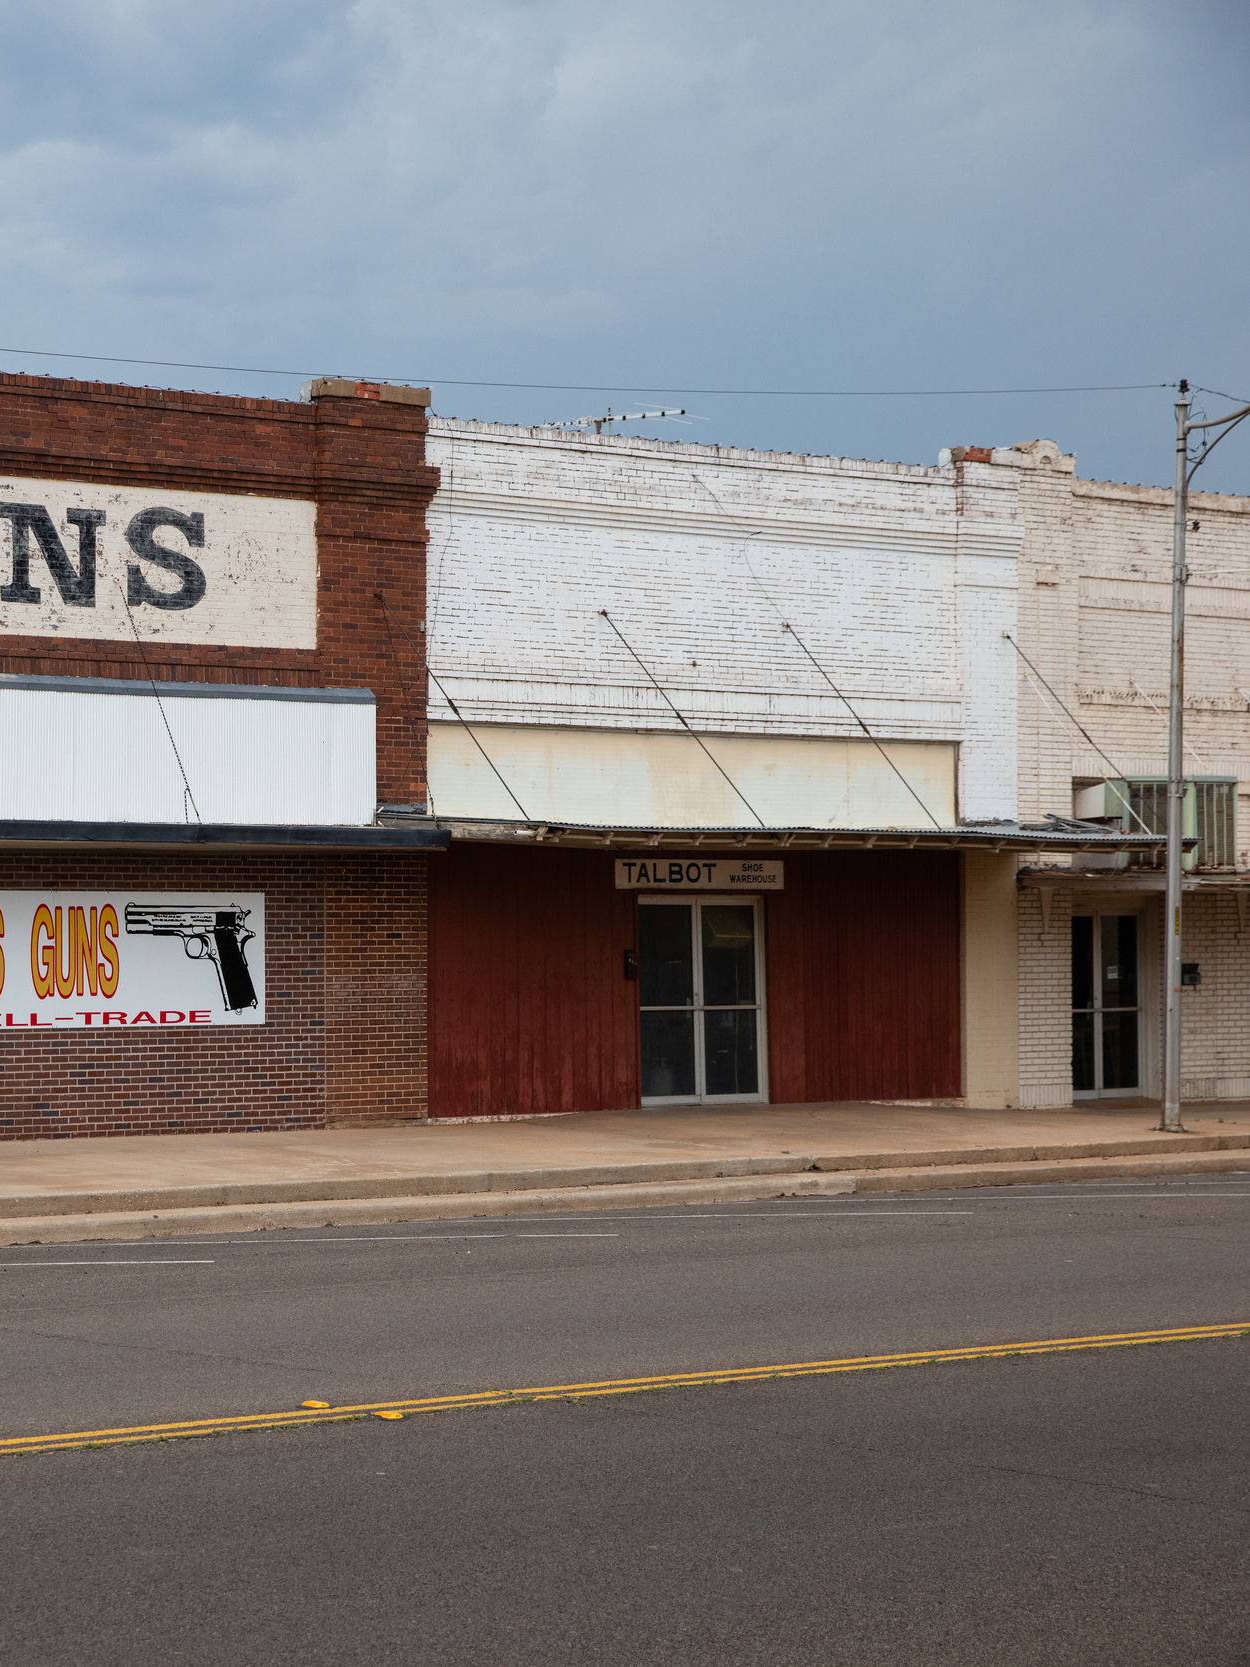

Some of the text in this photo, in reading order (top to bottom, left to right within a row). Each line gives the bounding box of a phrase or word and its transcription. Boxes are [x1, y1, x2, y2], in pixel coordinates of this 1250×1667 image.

[623, 863, 717, 883] TALBOT
[742, 863, 764, 872] SHOE
[729, 874, 777, 883] WAREHOUSE
[30, 903, 120, 1000] GUNS
